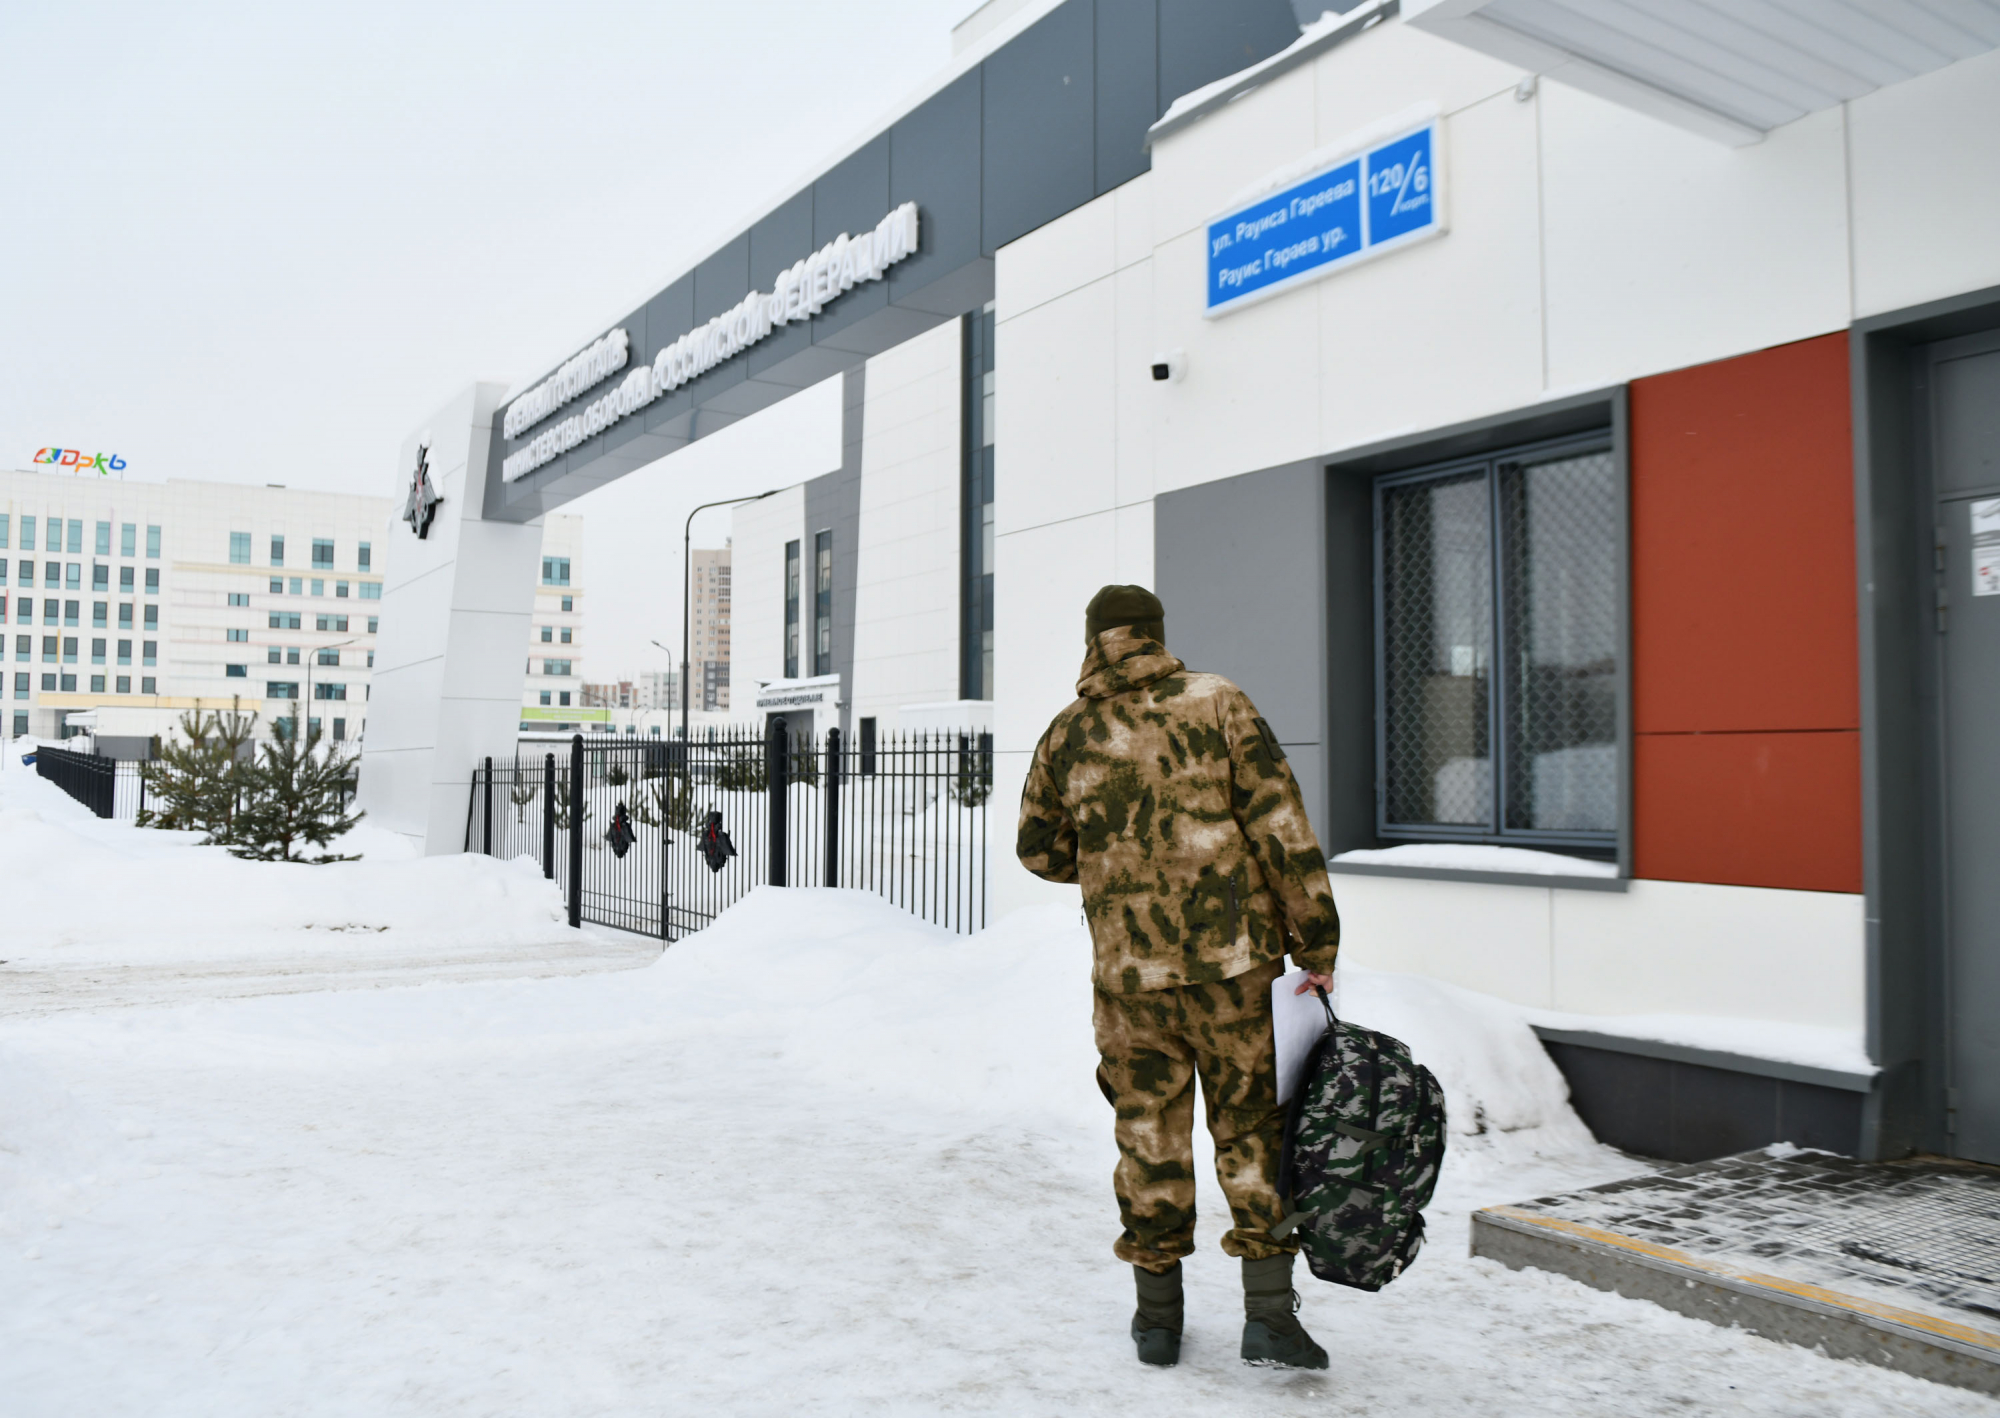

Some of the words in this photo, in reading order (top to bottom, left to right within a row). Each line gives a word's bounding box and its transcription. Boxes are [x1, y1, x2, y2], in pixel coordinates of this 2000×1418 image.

[1212, 230, 1234, 257] ул.
[1236, 205, 1288, 242] Рауиса
[1290, 177, 1355, 219] Гареева
[1219, 256, 1262, 288] Рауис
[1264, 235, 1319, 271] Гараев
[1321, 225, 1347, 253] ур.
[502, 414, 586, 482] МИНИСТЕРСТВА
[583, 368, 655, 436] ОБОРОНЫ
[652, 297, 772, 398] РОССИЙСКОЙ
[768, 206, 918, 325] ФЕДЕРАЦИИ
[551, 335, 628, 410] ГОСПИТАЛЬ
